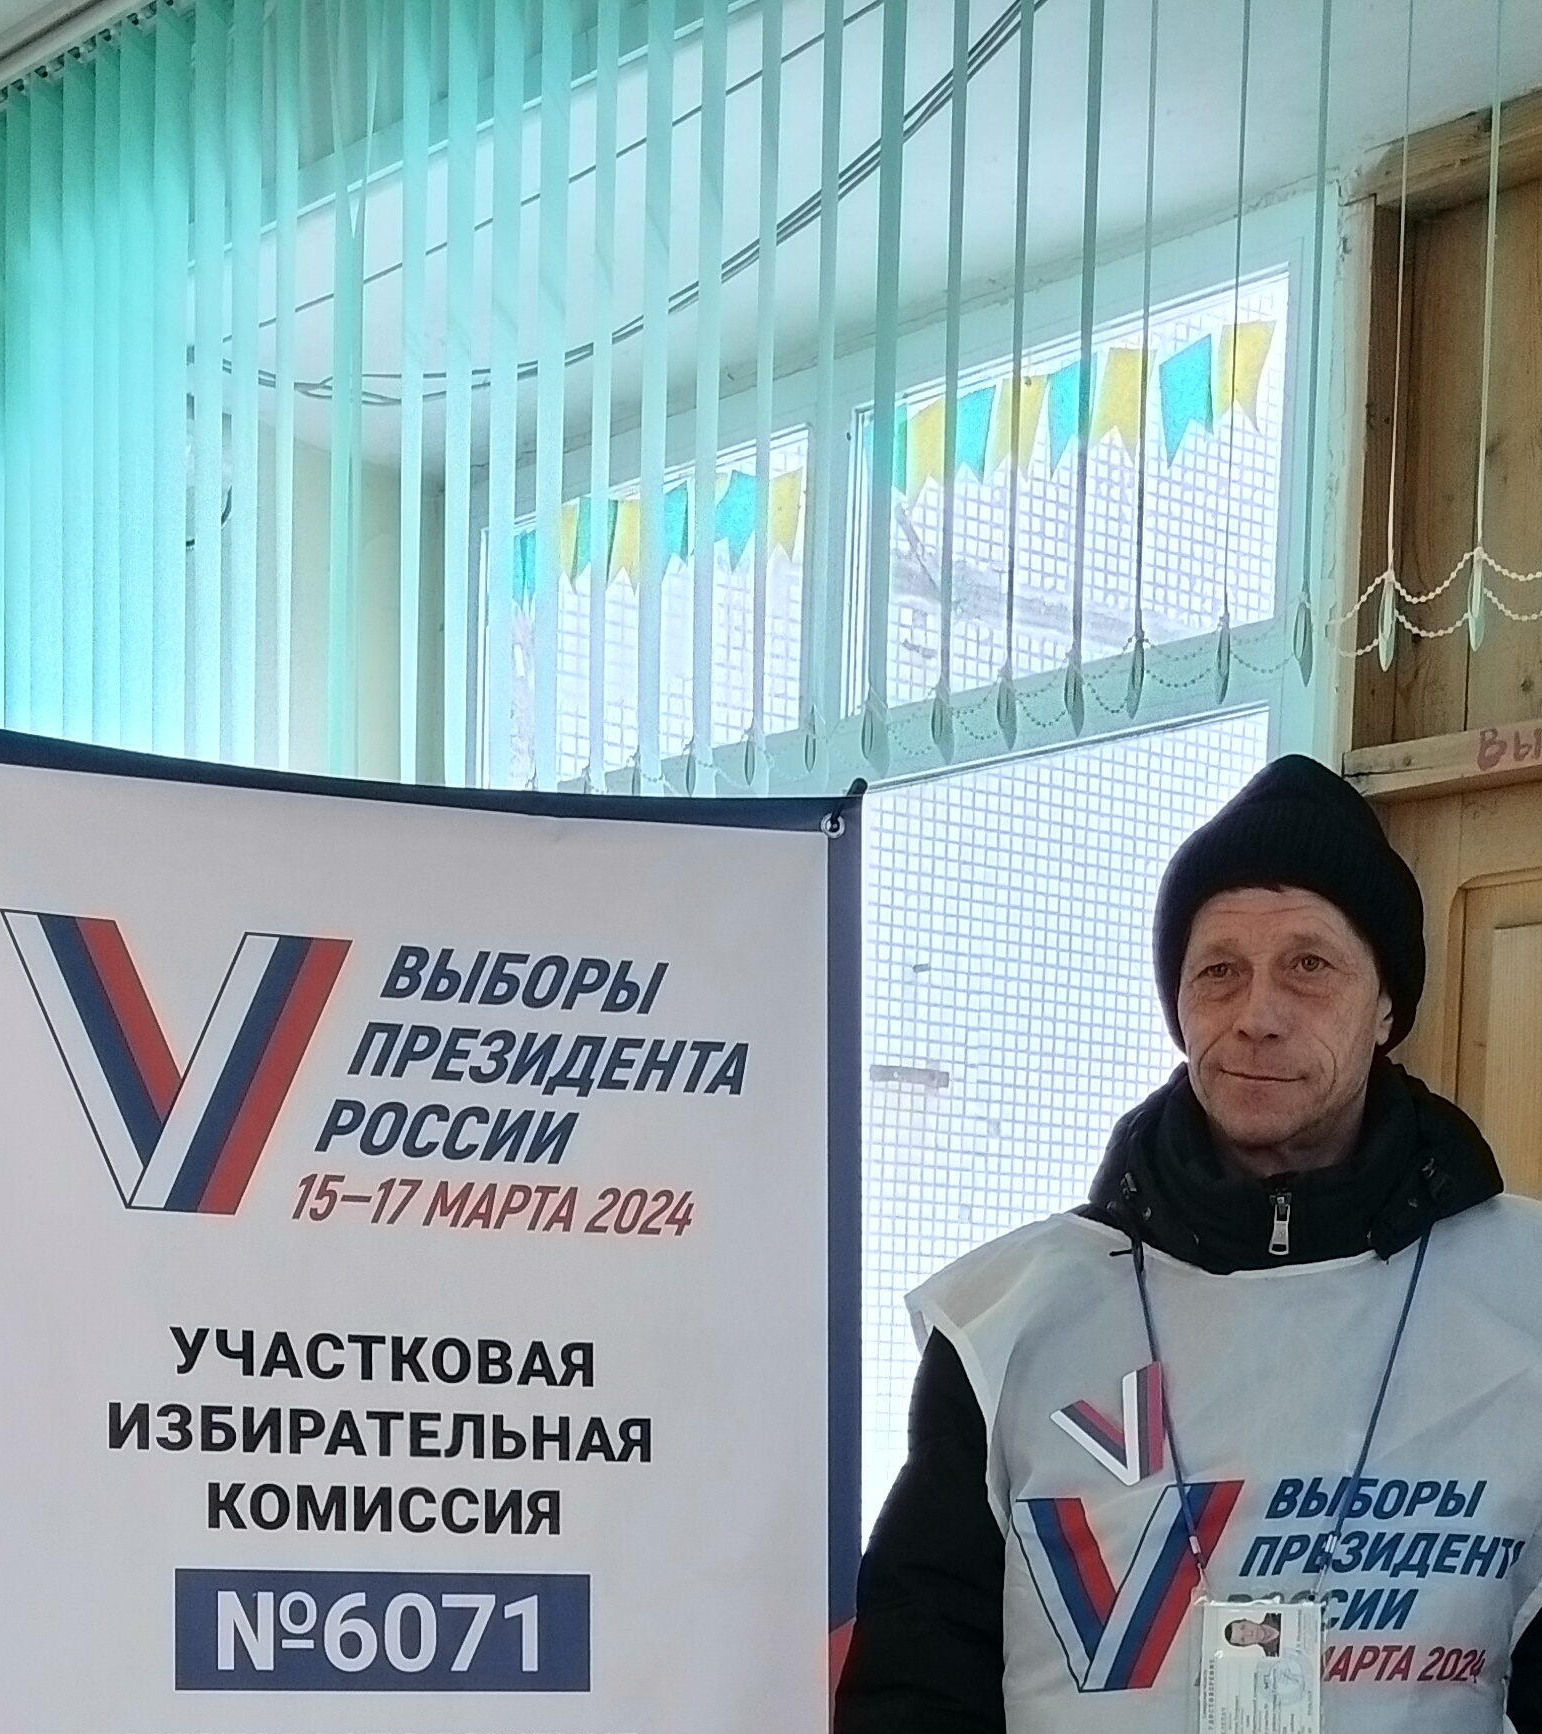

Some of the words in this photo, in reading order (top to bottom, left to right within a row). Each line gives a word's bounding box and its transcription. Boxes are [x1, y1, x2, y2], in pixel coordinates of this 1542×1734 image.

[380, 944, 669, 1015] ВЫБОРЫ
[348, 1022, 750, 1097] ПРЕЗИДЕНТА
[314, 1100, 579, 1165] РОССИИ
[423, 1178, 578, 1233] МАРТА
[585, 1187, 695, 1236] 2024
[170, 1326, 595, 1387] УЧАСТКОВАЯ
[108, 1402, 653, 1463] ИЗБИРАТЕЛЬНАЯ
[207, 1482, 561, 1535] КОМИССИЯ
[1265, 1477, 1487, 1520] ВЫБОРЫ
[1239, 1530, 1525, 1579] ПРЕЗИДЕНТ
[216, 1590, 541, 1673] №6071
[1417, 1645, 1486, 1684] 2024
